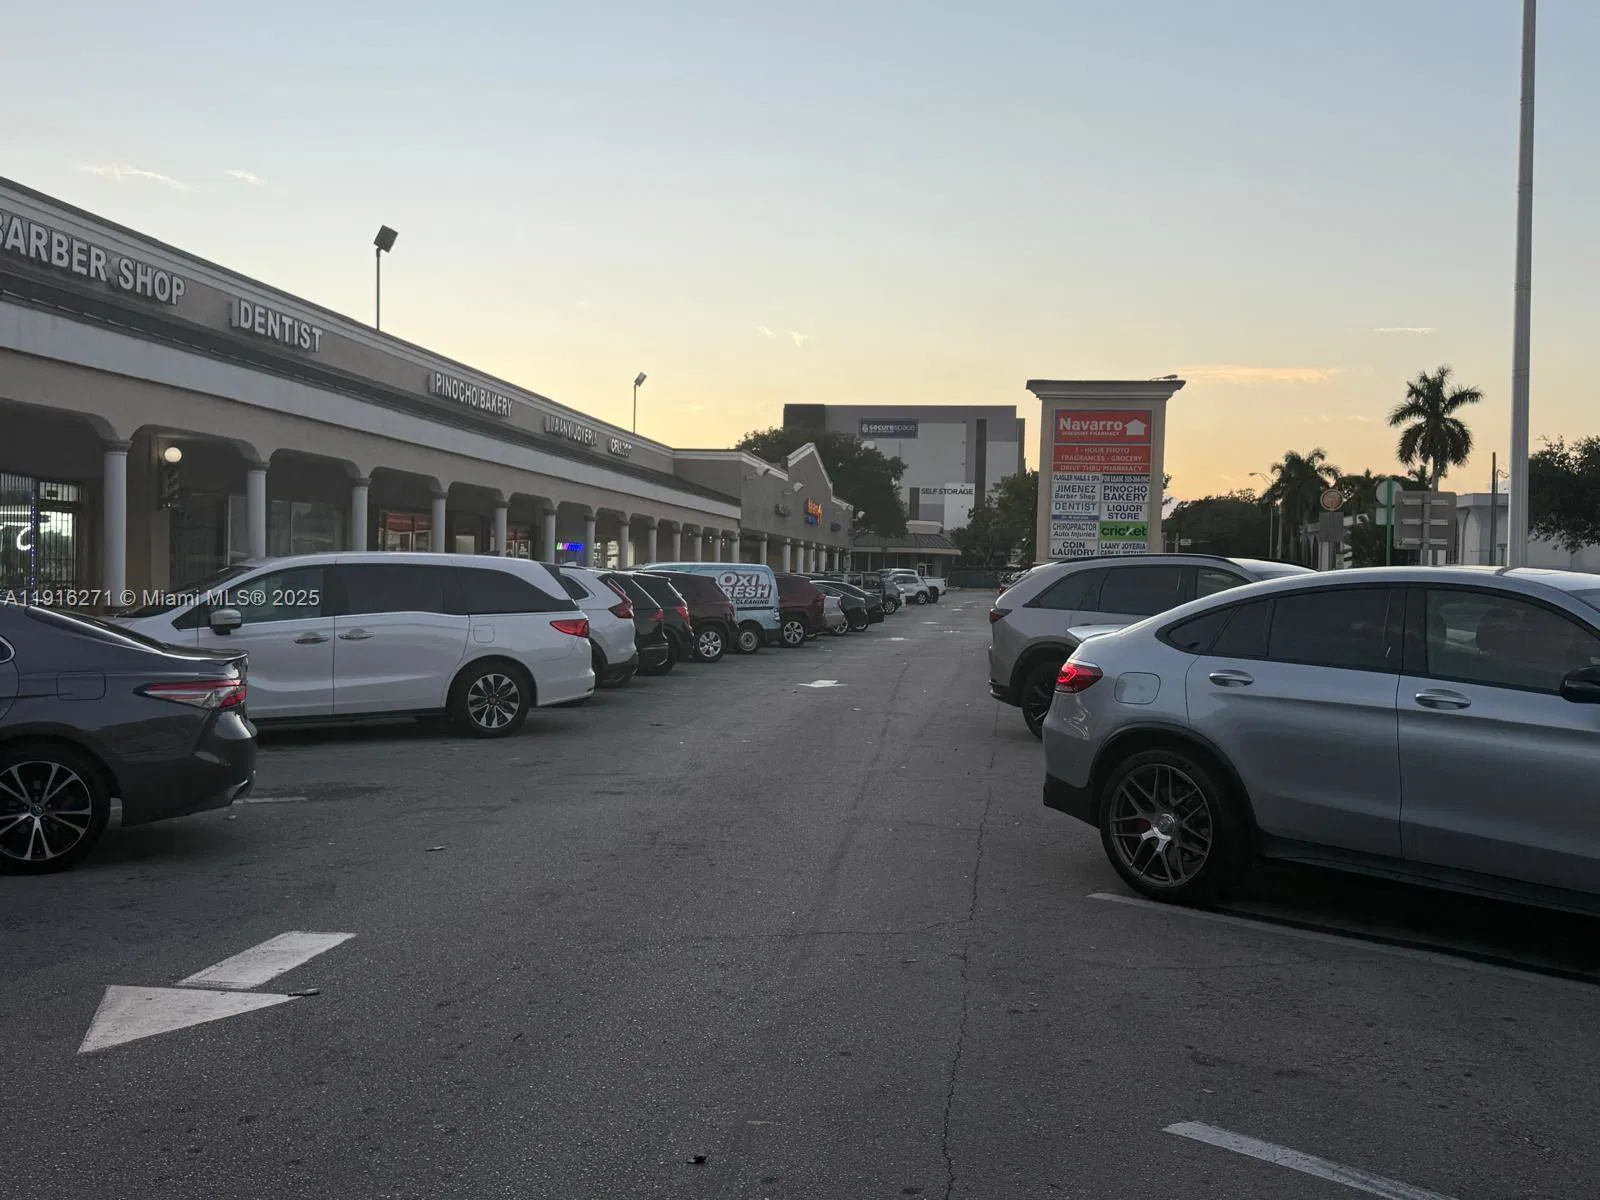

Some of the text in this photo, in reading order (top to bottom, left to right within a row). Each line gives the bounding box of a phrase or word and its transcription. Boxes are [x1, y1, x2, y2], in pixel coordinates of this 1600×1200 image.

[0, 212, 185, 305] ARBER SHOP
[238, 300, 323, 352] DENTIST
[434, 373, 513, 417] PINOCHO BAKERY
[1059, 416, 1123, 431] Navarro
[1056, 485, 1096, 493] JIMENEZ
[1103, 485, 1148, 493] PINOCHO
[1079, 493, 1096, 501] Shop
[1103, 493, 1148, 501] BAKERY
[1054, 502, 1097, 511] DENTIST
[1107, 504, 1143, 513] LIQUOR
[1108, 512, 1140, 520] STORE
[1052, 522, 1097, 531] CHIROPRACTOR
[1101, 525, 1148, 537] cricket
[1071, 531, 1096, 539] Injuries
[1062, 541, 1086, 549] COIN
[1052, 548, 1096, 556] LAUNDRY
[719, 571, 760, 587] OXI
[721, 584, 772, 599] RESH
